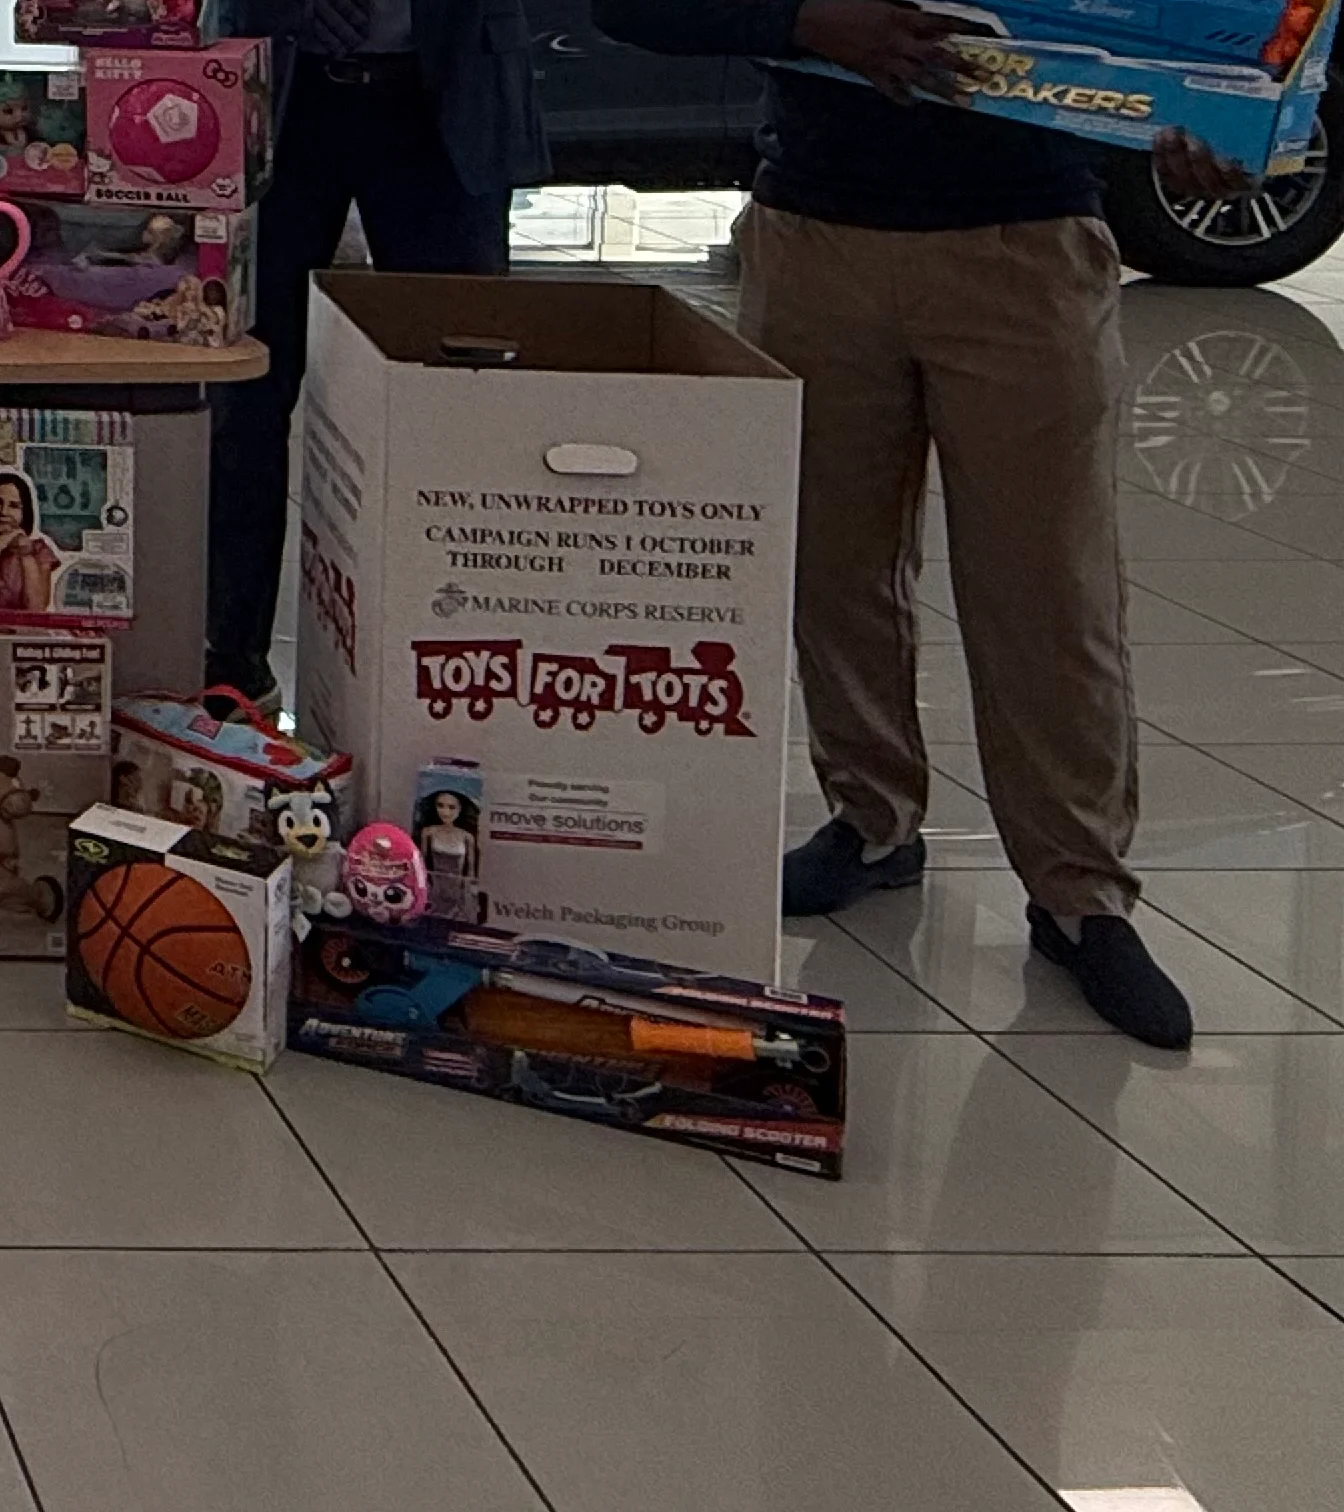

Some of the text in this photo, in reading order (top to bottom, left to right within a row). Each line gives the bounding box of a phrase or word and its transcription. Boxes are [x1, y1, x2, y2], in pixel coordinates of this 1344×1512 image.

[95, 188, 191, 204] SOCCER BALL
[416, 490, 765, 523] NEW, UNWRAPPED TOYS ONLY
[424, 524, 755, 557] CAMPAIGN RUNS 1 OCTOBER
[446, 550, 732, 581] THROUGH DECEMBER
[469, 595, 745, 626] MARINE CORPS RESERVE
[421, 649, 730, 717] TOYS FOR TOTS
[489, 809, 645, 835] move solutions
[493, 899, 726, 937] Welch Packaging Group
